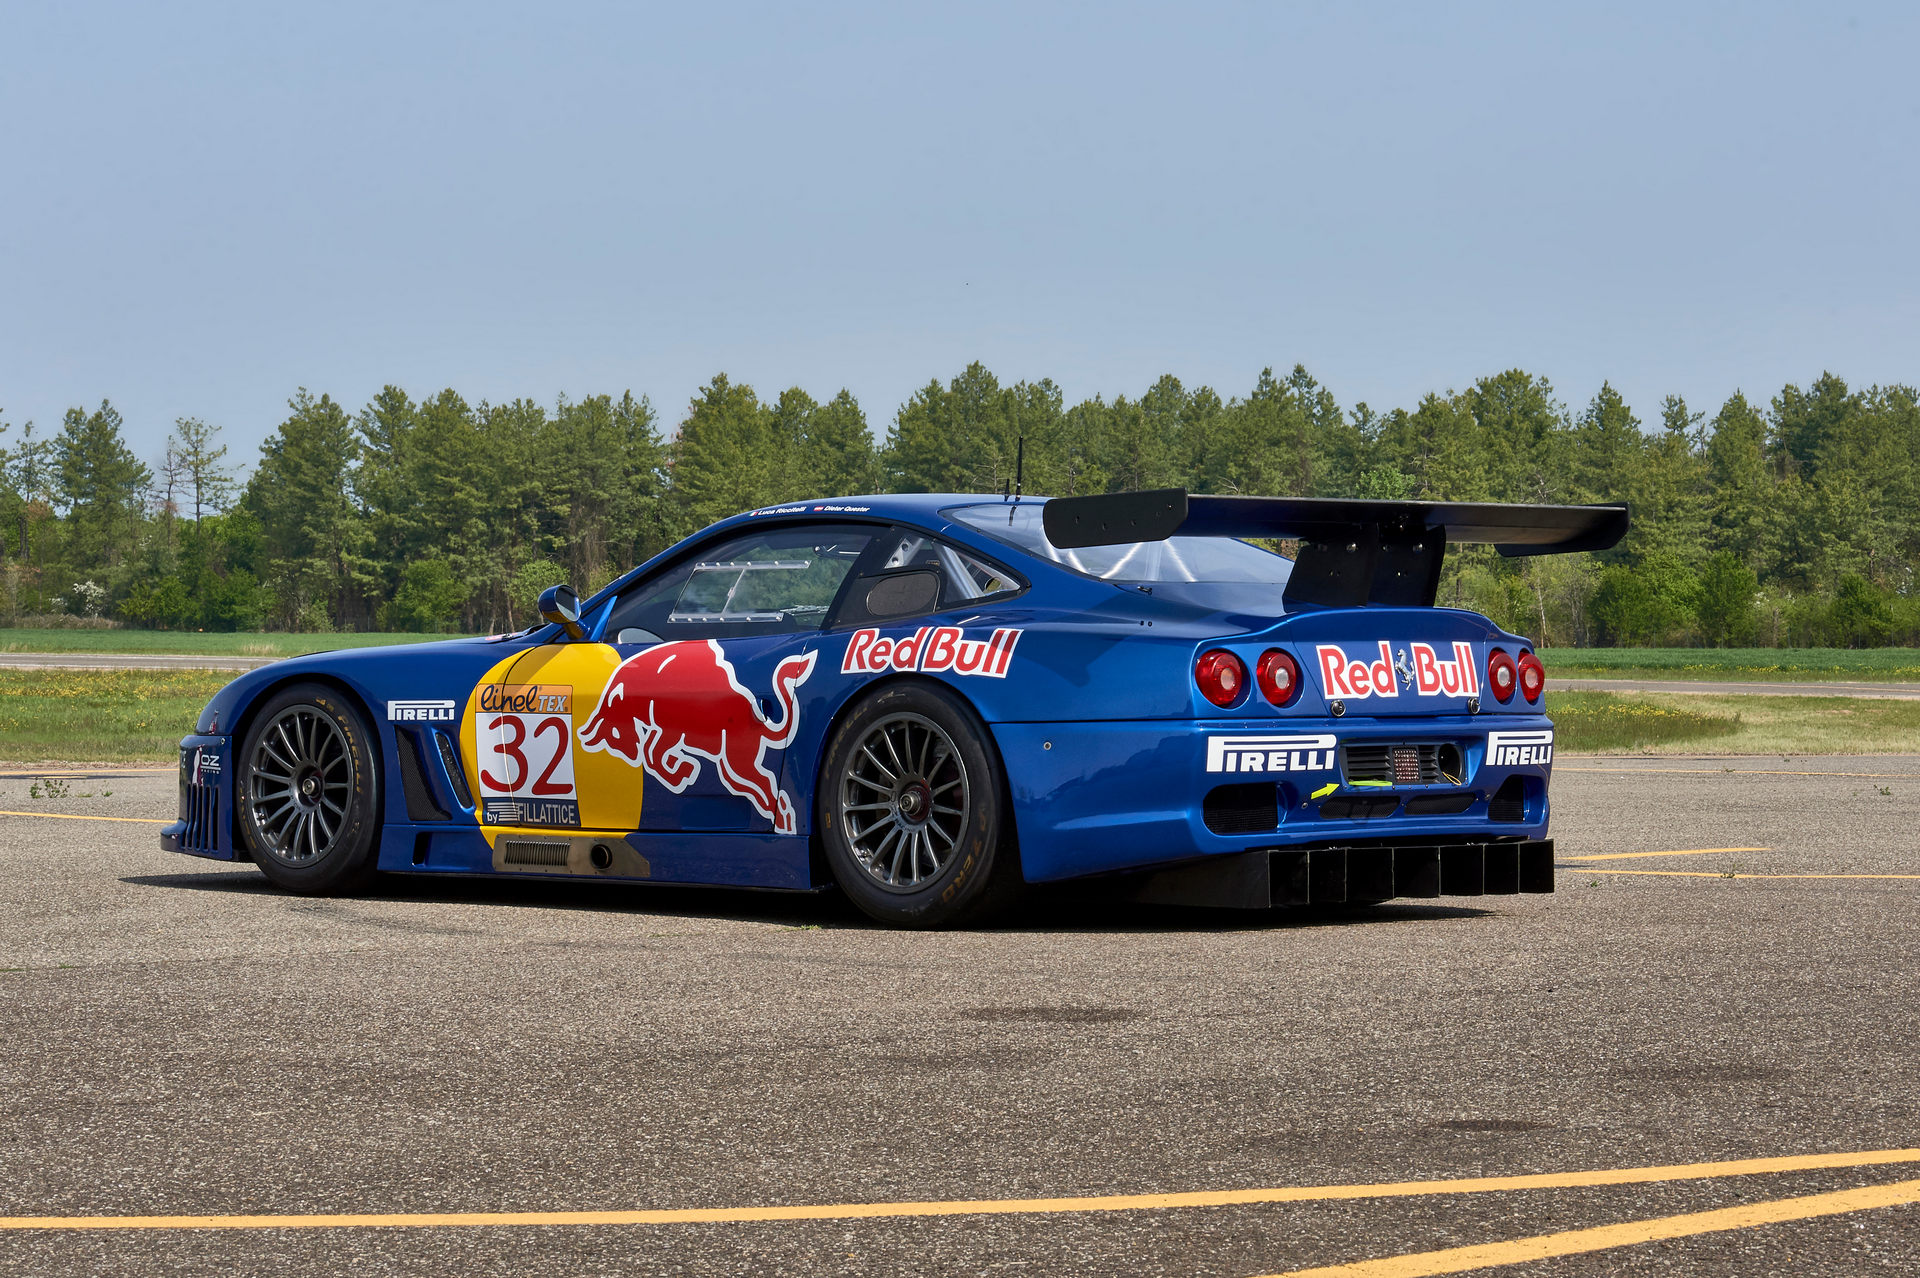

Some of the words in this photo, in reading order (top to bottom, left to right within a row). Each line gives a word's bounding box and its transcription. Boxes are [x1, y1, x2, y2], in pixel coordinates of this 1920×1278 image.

[841, 626, 934, 674] Red
[920, 627, 1024, 678] Bull
[1316, 640, 1399, 700] Red
[1410, 641, 1480, 698] Bull
[387, 700, 456, 721] PIRELLI
[200, 754, 220, 767] OZ
[480, 715, 574, 796] 32
[1206, 734, 1338, 773] PIRELLI
[1485, 730, 1554, 766] PIRELLI
[486, 812, 498, 824] by
[517, 802, 575, 824] FILLATTICE
